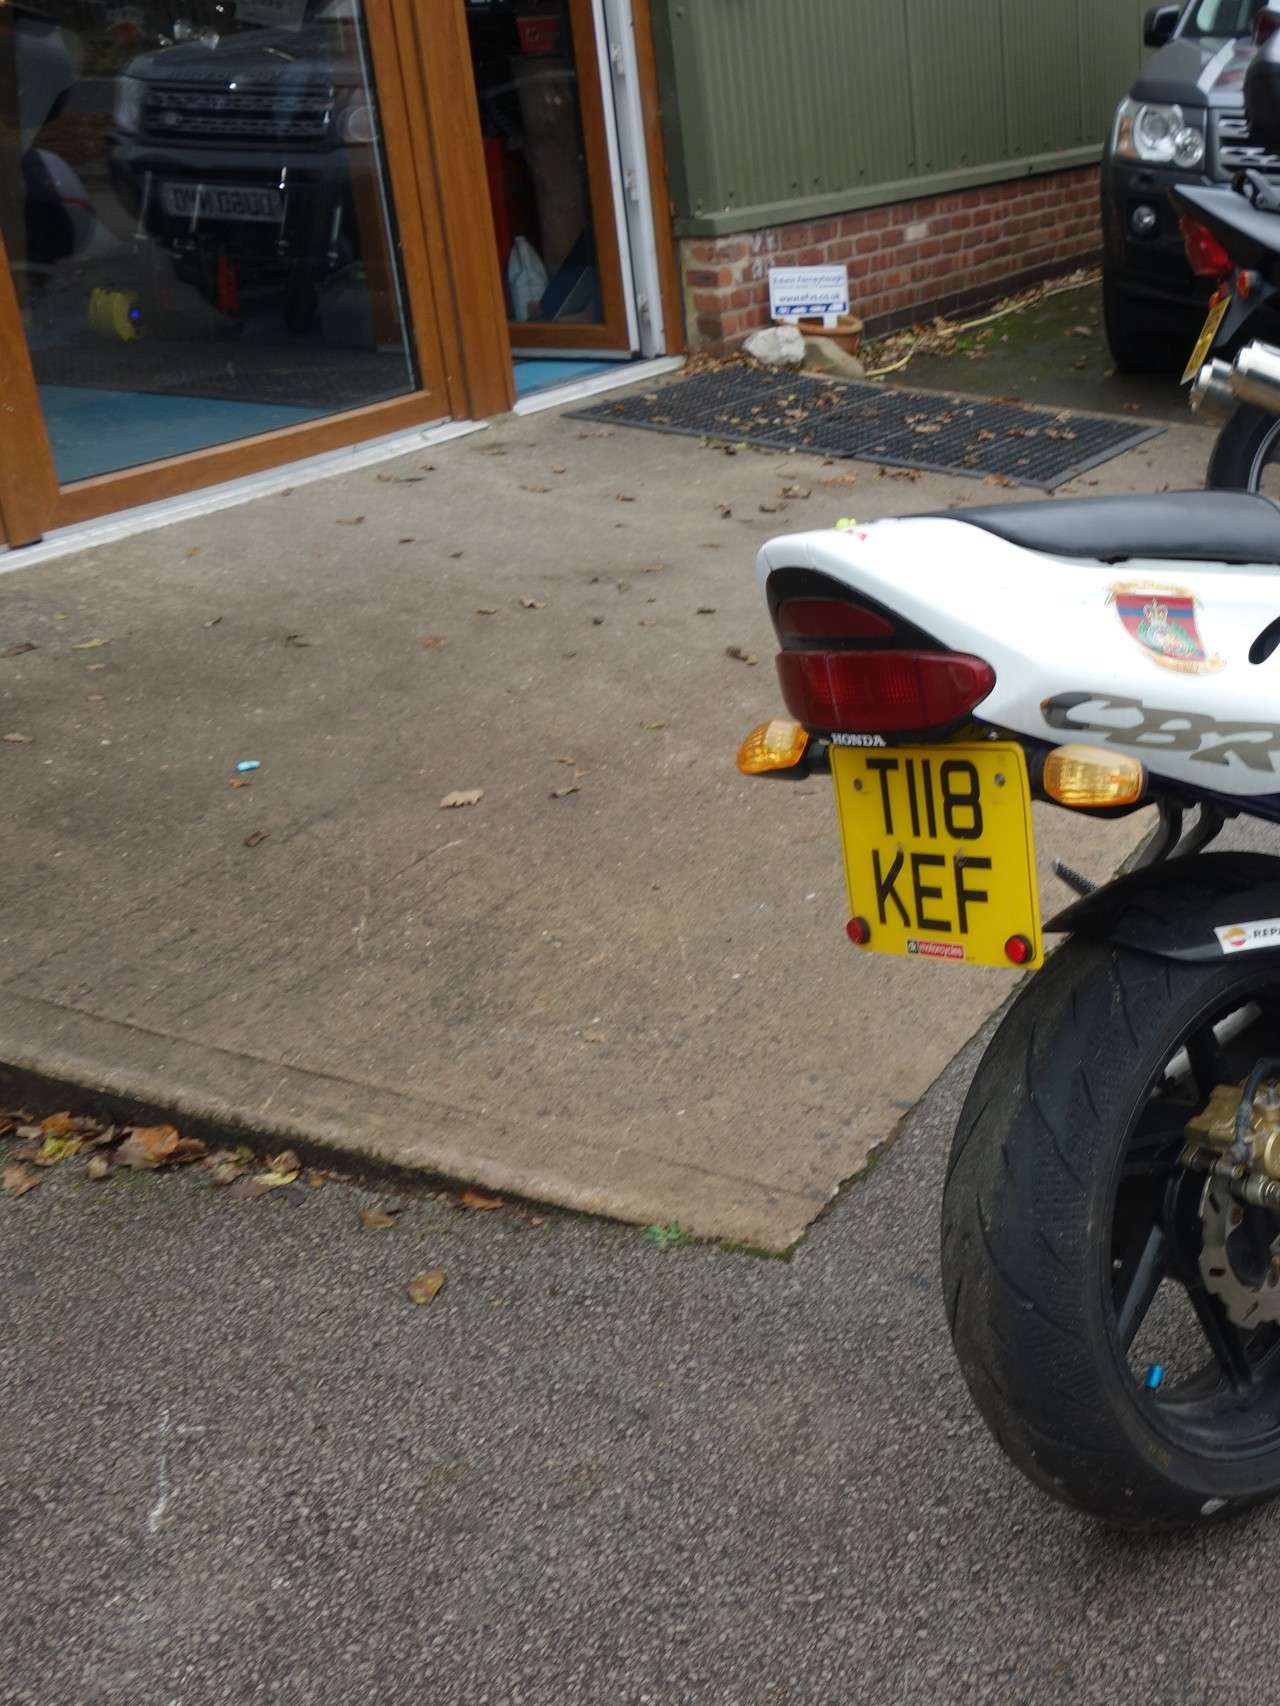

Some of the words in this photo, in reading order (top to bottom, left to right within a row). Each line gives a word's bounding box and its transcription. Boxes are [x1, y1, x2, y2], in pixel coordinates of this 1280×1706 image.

[831, 732, 887, 747] HONDA
[865, 757, 983, 840] T118
[872, 849, 992, 934] KEF
